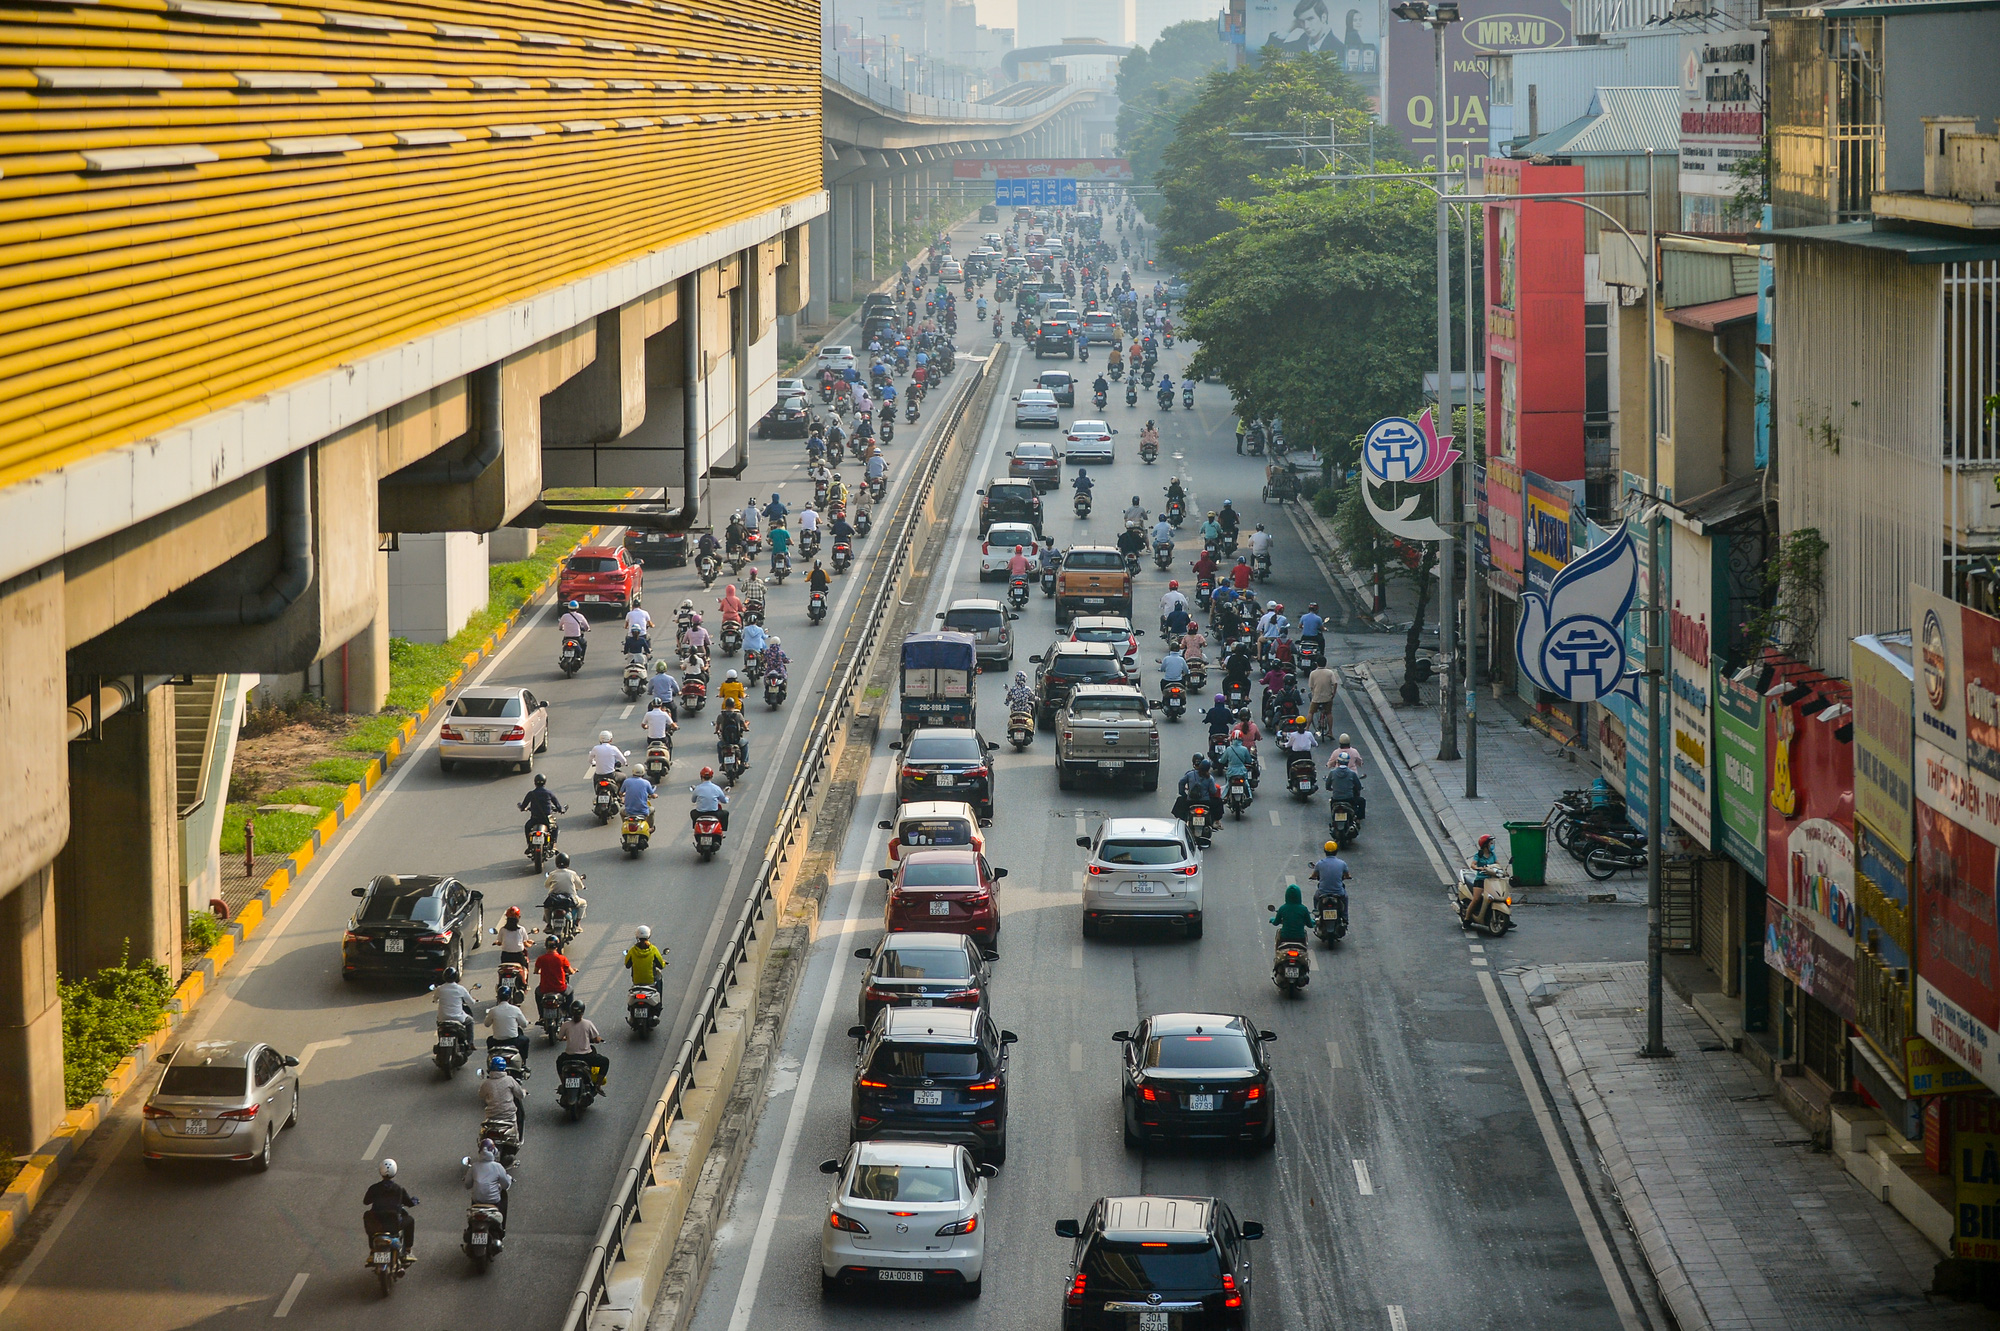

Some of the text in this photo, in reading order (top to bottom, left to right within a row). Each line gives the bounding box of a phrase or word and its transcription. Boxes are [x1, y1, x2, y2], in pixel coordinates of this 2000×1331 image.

[1478, 21, 1546, 45] MR VU
[1453, 60, 1489, 73] MAD
[1406, 95, 1489, 135] QUẠ
[1026, 163, 1051, 175] Fasty
[1927, 755, 1948, 797] THIẾT
[1960, 777, 1980, 821] ĐIỆN
[1190, 1102, 1213, 1110] 487.93
[879, 1271, 923, 1281] 29A-008.16
[1146, 1313, 1162, 1322] 30A
[1140, 1322, 1168, 1331] 692.05
